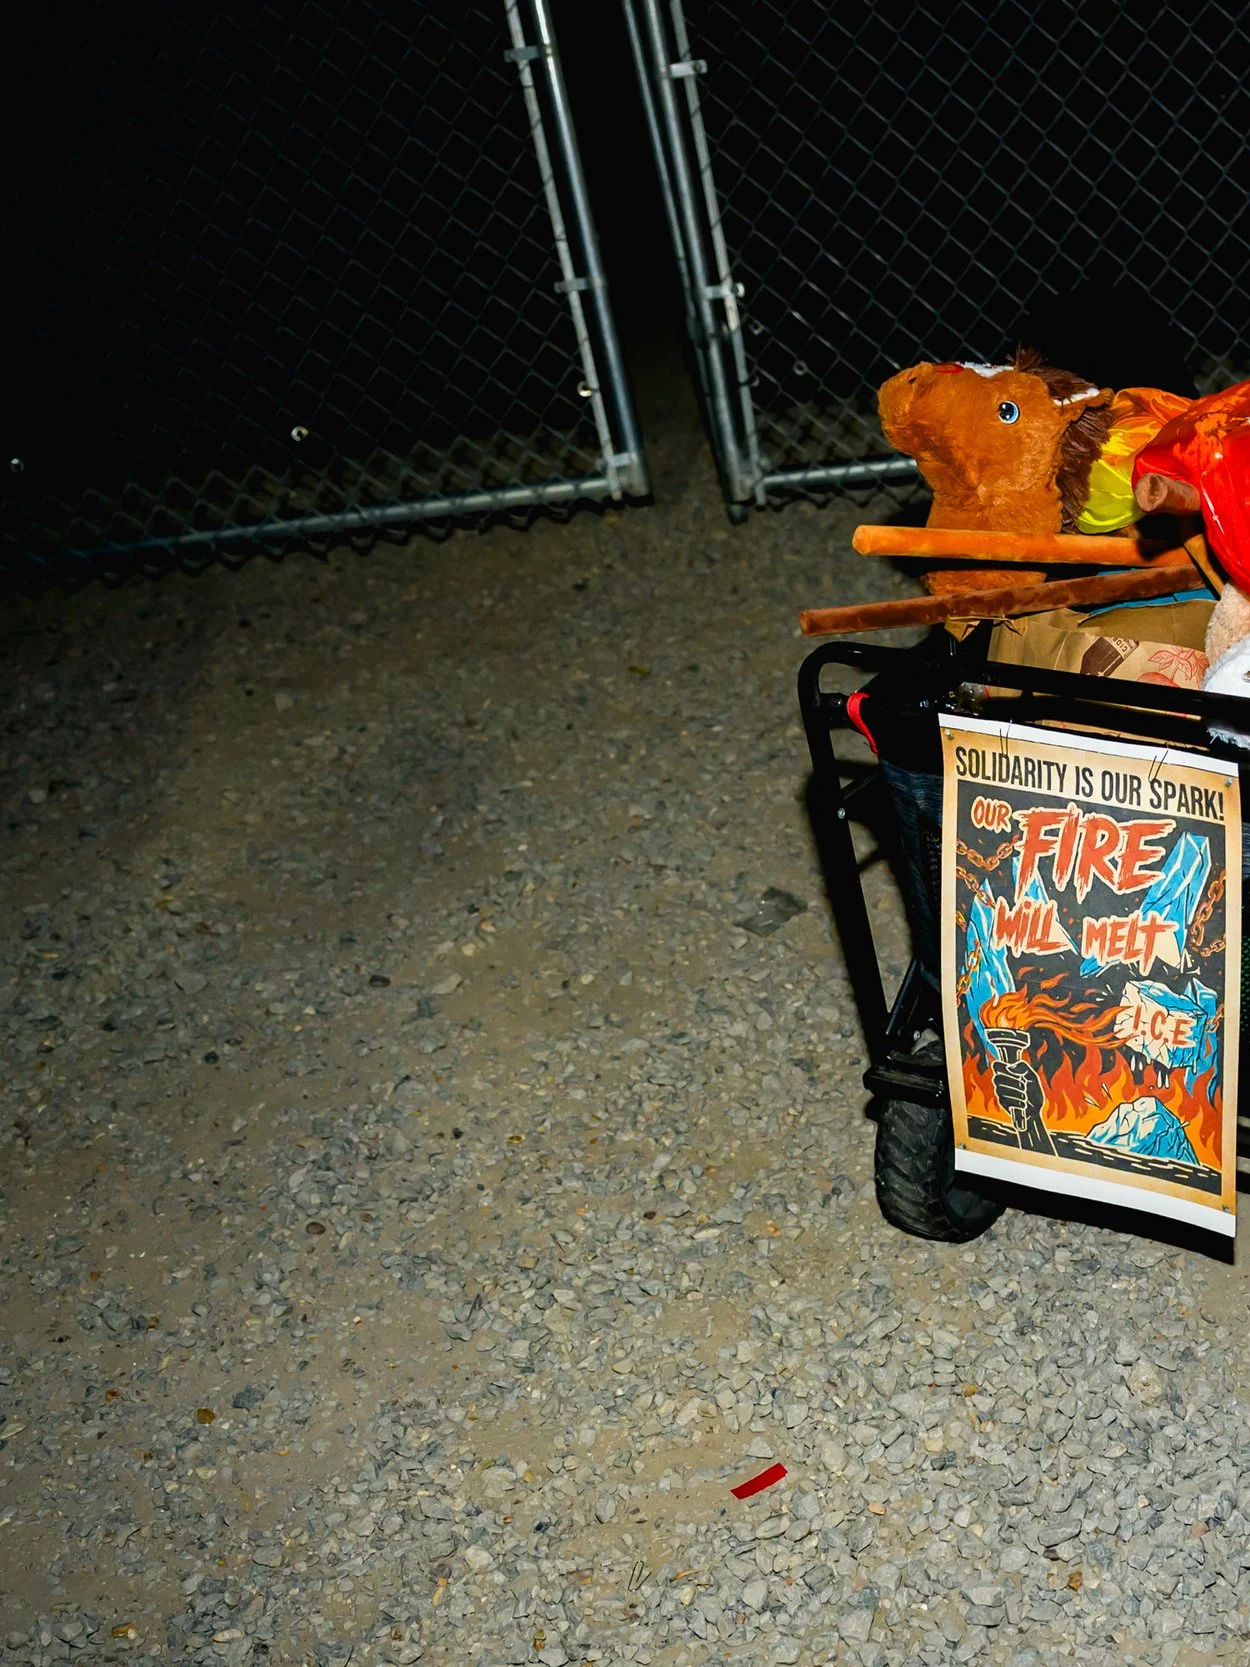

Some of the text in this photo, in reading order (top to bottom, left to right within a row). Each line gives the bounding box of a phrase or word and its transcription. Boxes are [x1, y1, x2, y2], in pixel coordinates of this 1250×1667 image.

[955, 746, 1225, 821] SOLIDARITY IS OUR SPARK!
[972, 799, 1011, 831] OUR
[1015, 805, 1175, 900] FIRE
[1084, 915, 1177, 972] MELT
